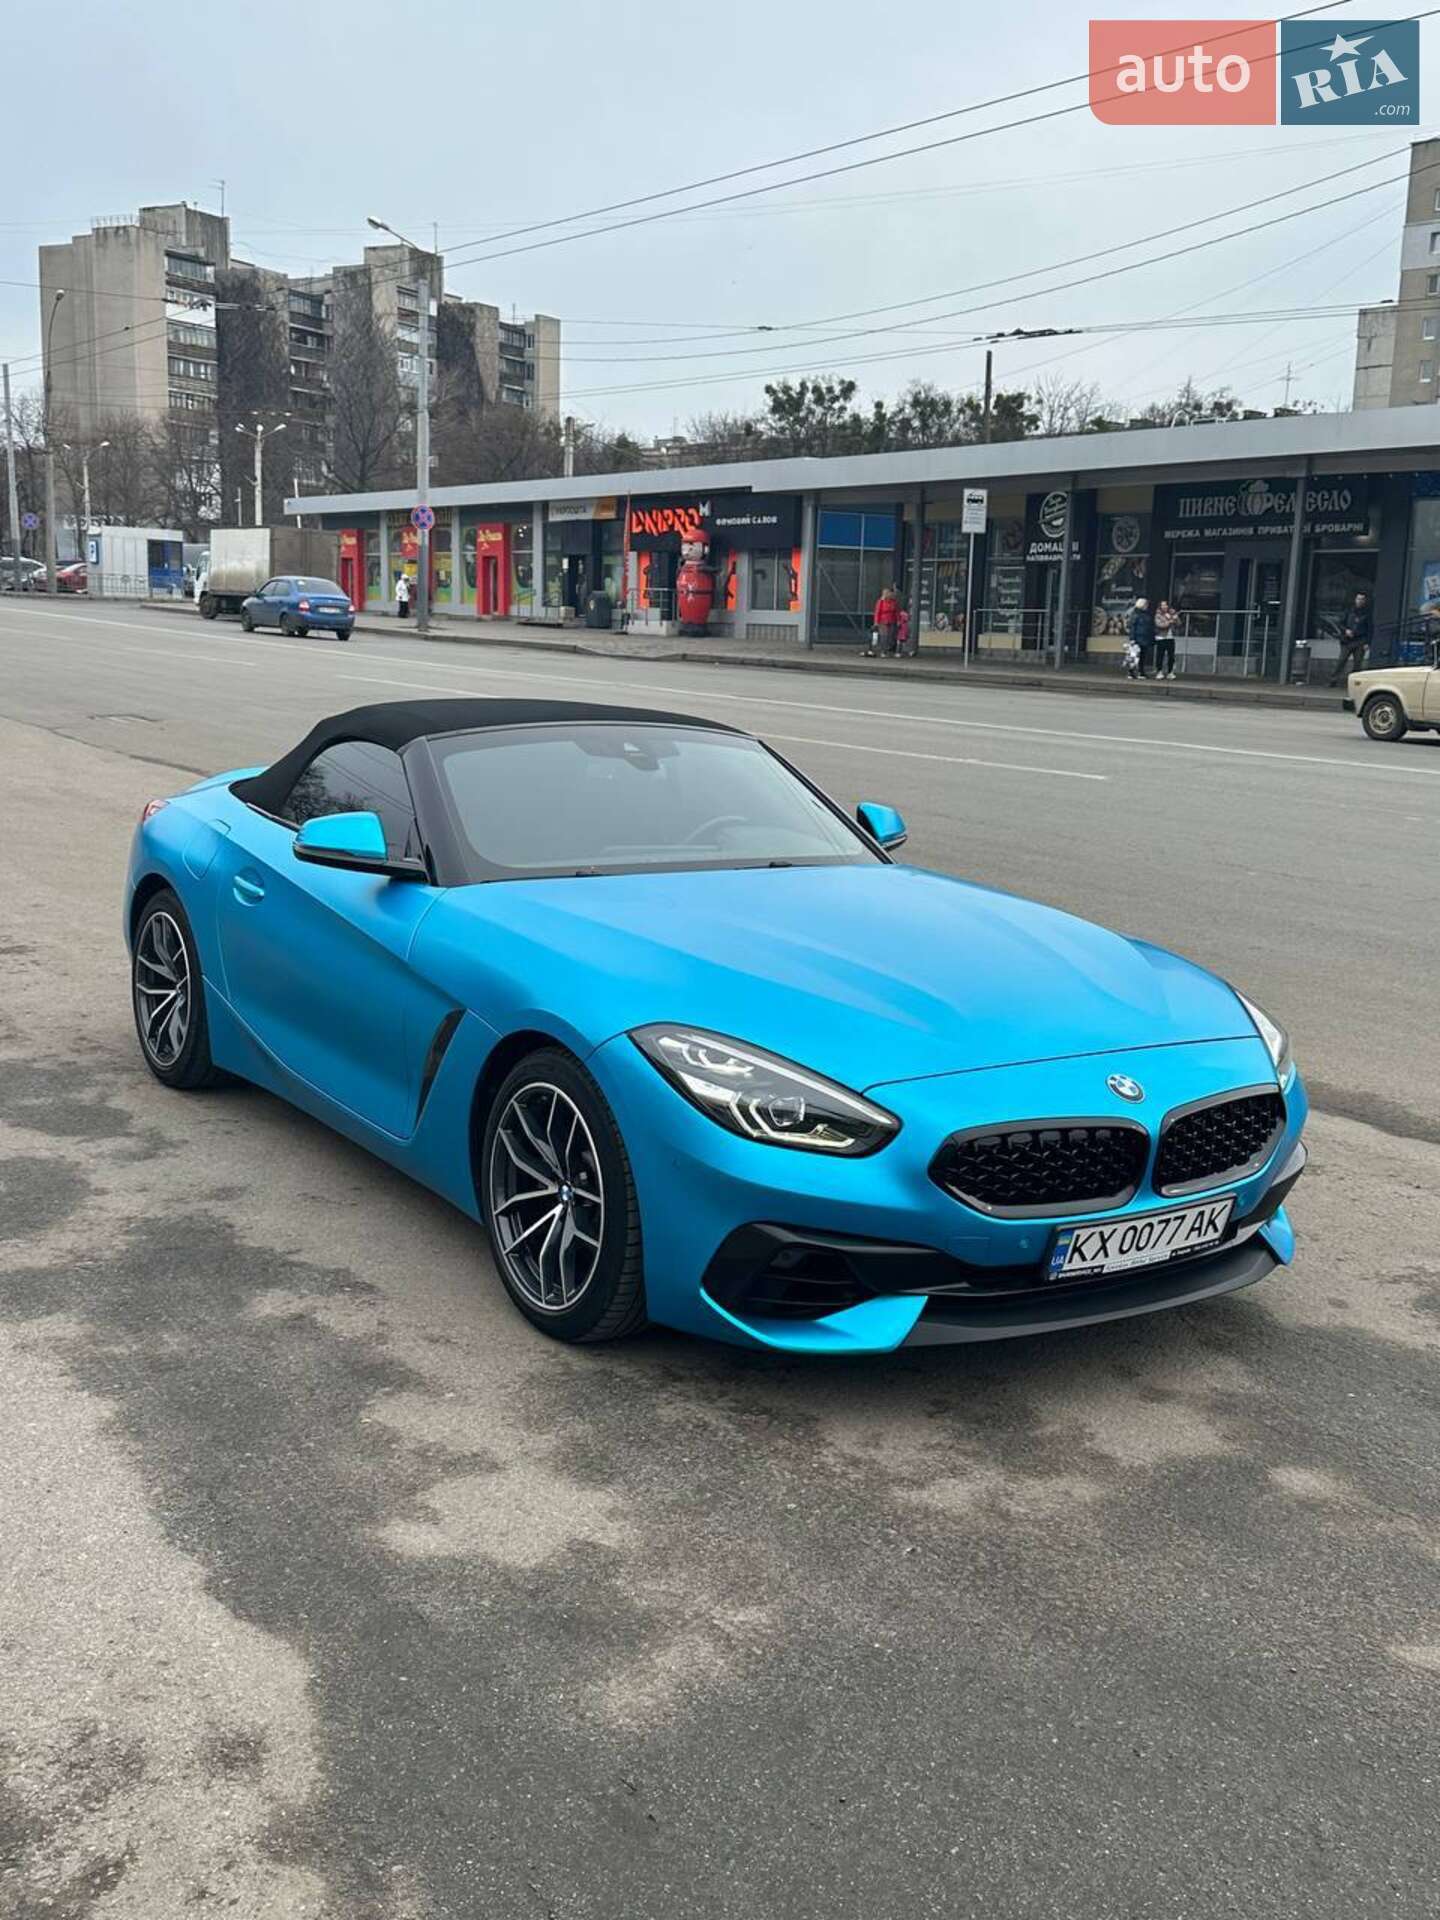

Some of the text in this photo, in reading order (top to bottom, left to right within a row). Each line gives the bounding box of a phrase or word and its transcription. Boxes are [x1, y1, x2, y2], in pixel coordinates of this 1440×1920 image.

[1178, 495, 1237, 518] ПИВНЕ
[1164, 529, 1201, 539] МЕРЕЖА
[1204, 526, 1254, 537] МАГАЗИНІВ
[1257, 523, 1311, 536] ПРИВАТОЇ
[1120, 1214, 1188, 1254] 0077
[1184, 1204, 1228, 1241] AK
